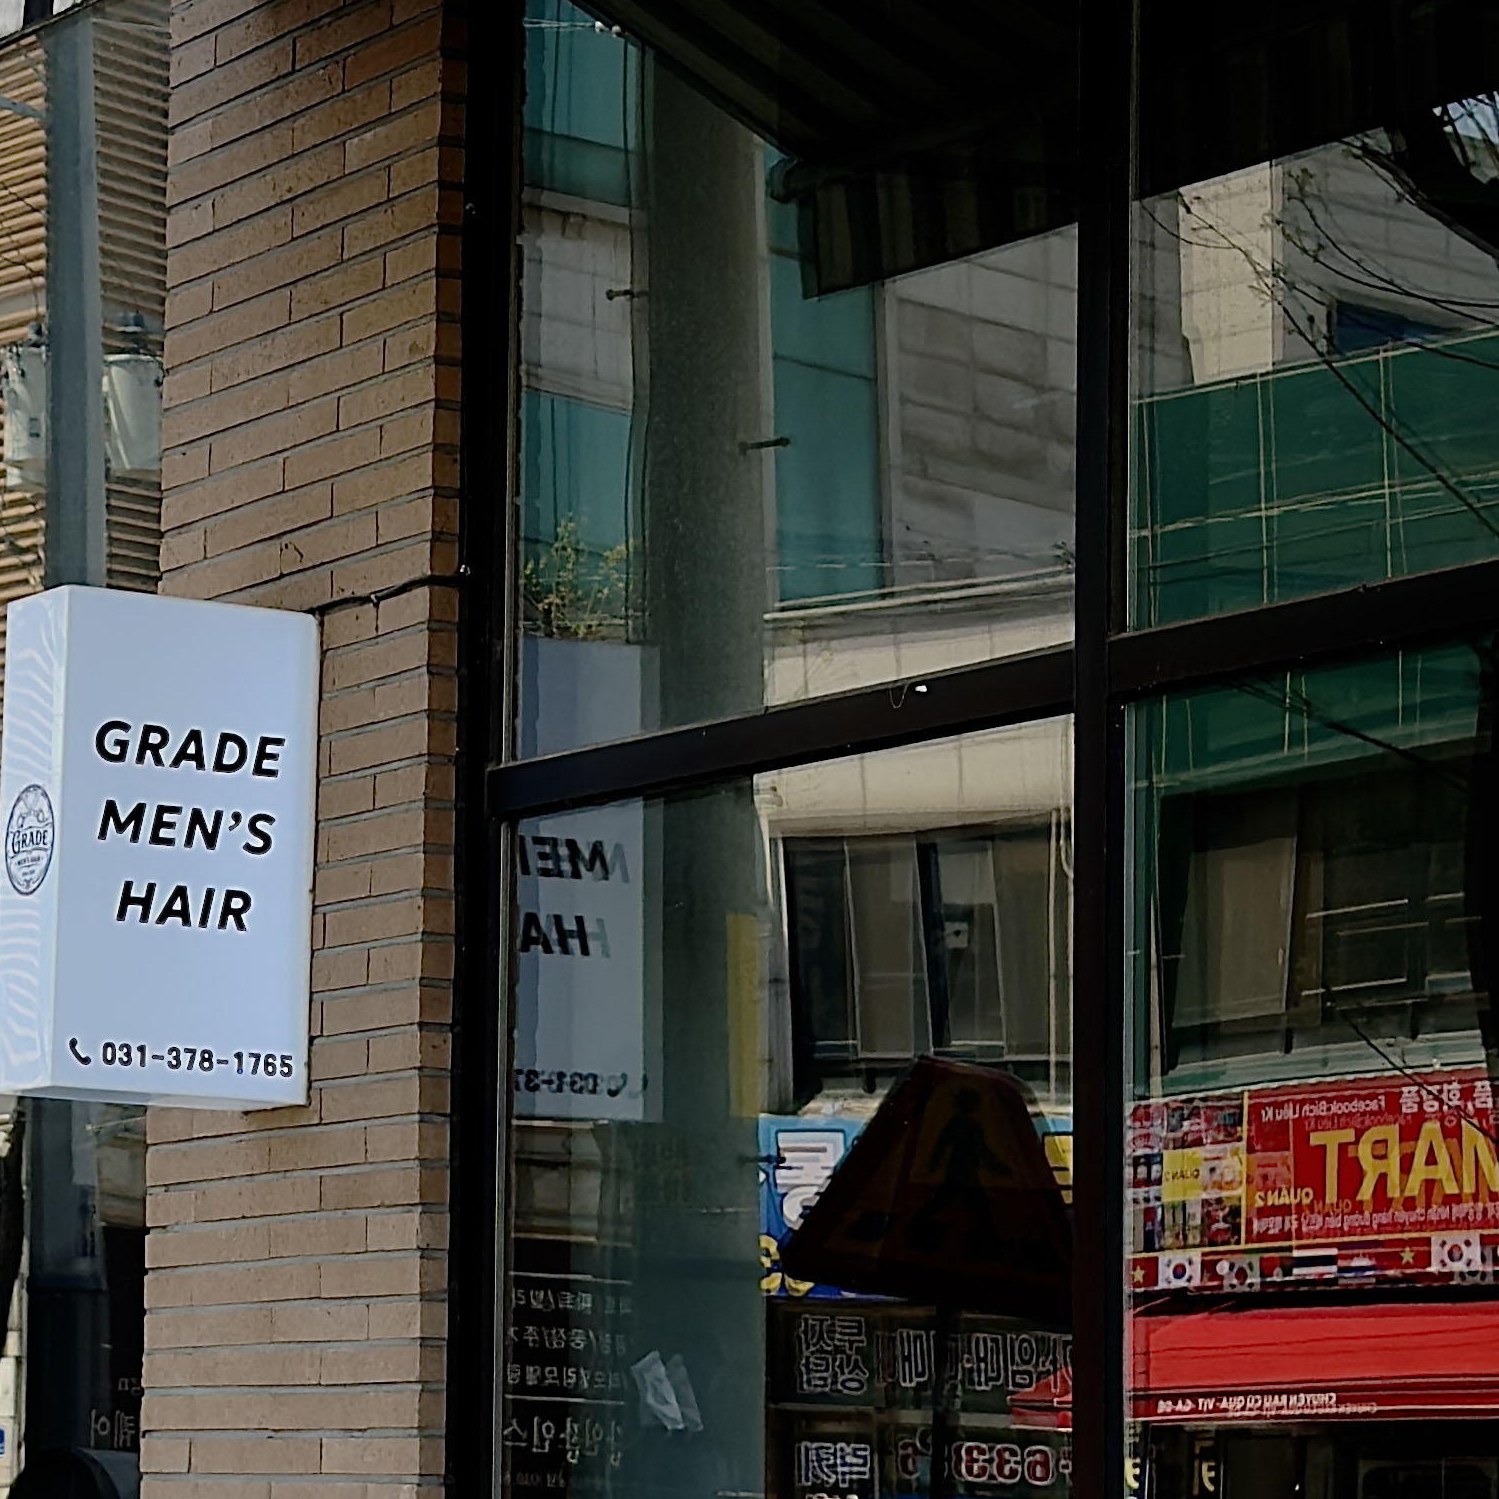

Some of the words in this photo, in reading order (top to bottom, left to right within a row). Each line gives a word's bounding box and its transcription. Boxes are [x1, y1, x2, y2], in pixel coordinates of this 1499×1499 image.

[94, 719, 286, 778] GRADE
[11, 829, 48, 855] GRADE
[97, 799, 275, 856] MEN'S
[115, 880, 252, 932] HAIR
[101, 1041, 294, 1078] 031-378-1765
